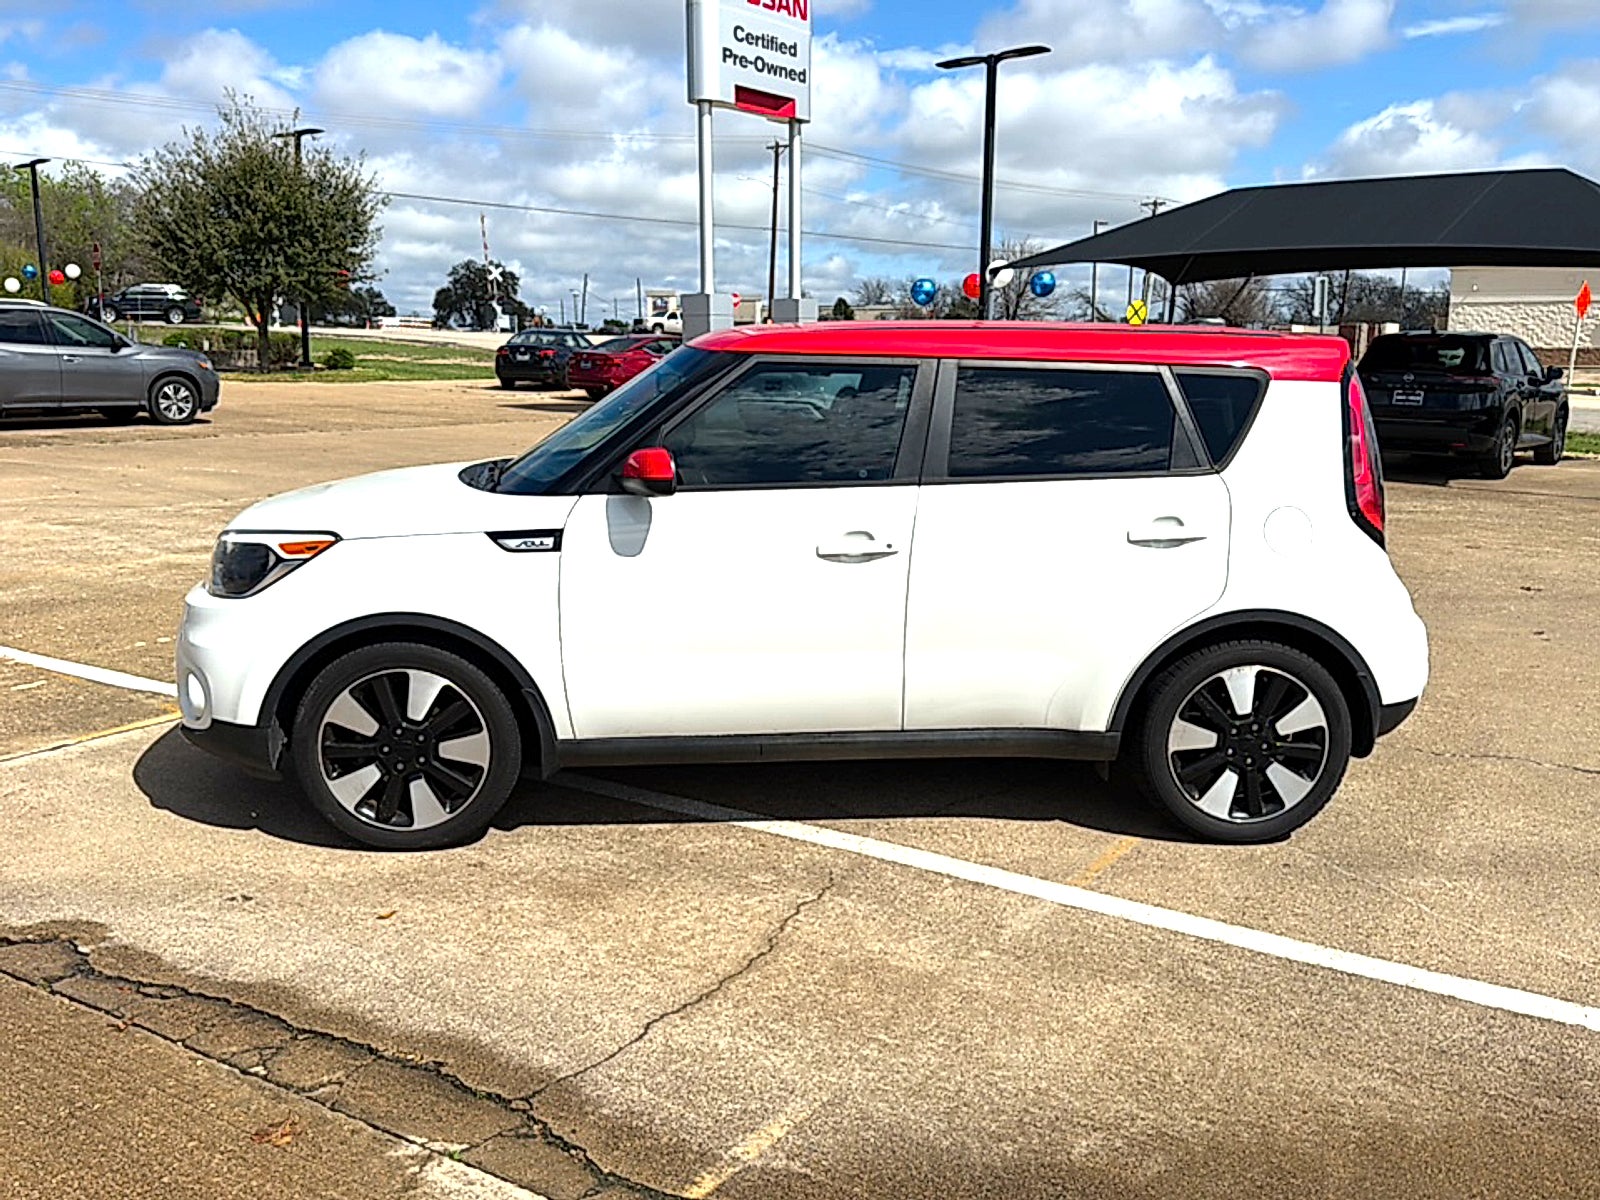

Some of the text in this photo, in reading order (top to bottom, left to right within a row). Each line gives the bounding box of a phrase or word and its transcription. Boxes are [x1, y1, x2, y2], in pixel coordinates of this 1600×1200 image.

[747, 0, 807, 21] AN
[733, 25, 798, 57] Certified
[722, 47, 806, 84] Pre-Owned
